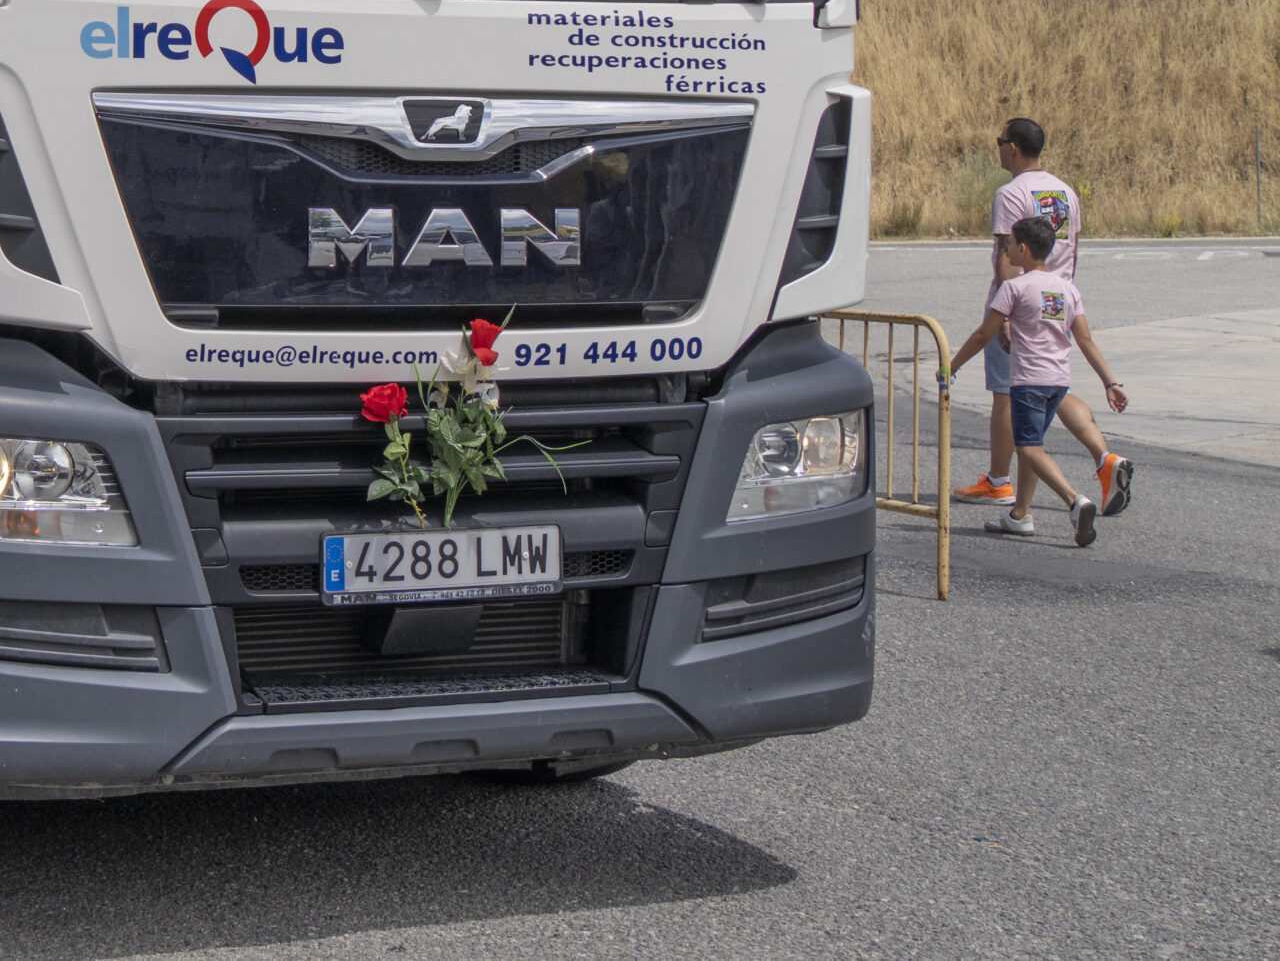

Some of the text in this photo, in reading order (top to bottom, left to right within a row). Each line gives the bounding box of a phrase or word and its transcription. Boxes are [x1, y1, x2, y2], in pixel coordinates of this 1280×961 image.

[527, 10, 675, 28] materiales
[567, 29, 767, 51] de construcción
[527, 52, 728, 73] recuperaciones
[664, 74, 767, 94] férricas
[308, 208, 581, 267] MAN
[185, 343, 438, 368] elreque@elreque.com
[514, 336, 703, 367] 921 444 000
[331, 533, 548, 583] E 4288 LMW
